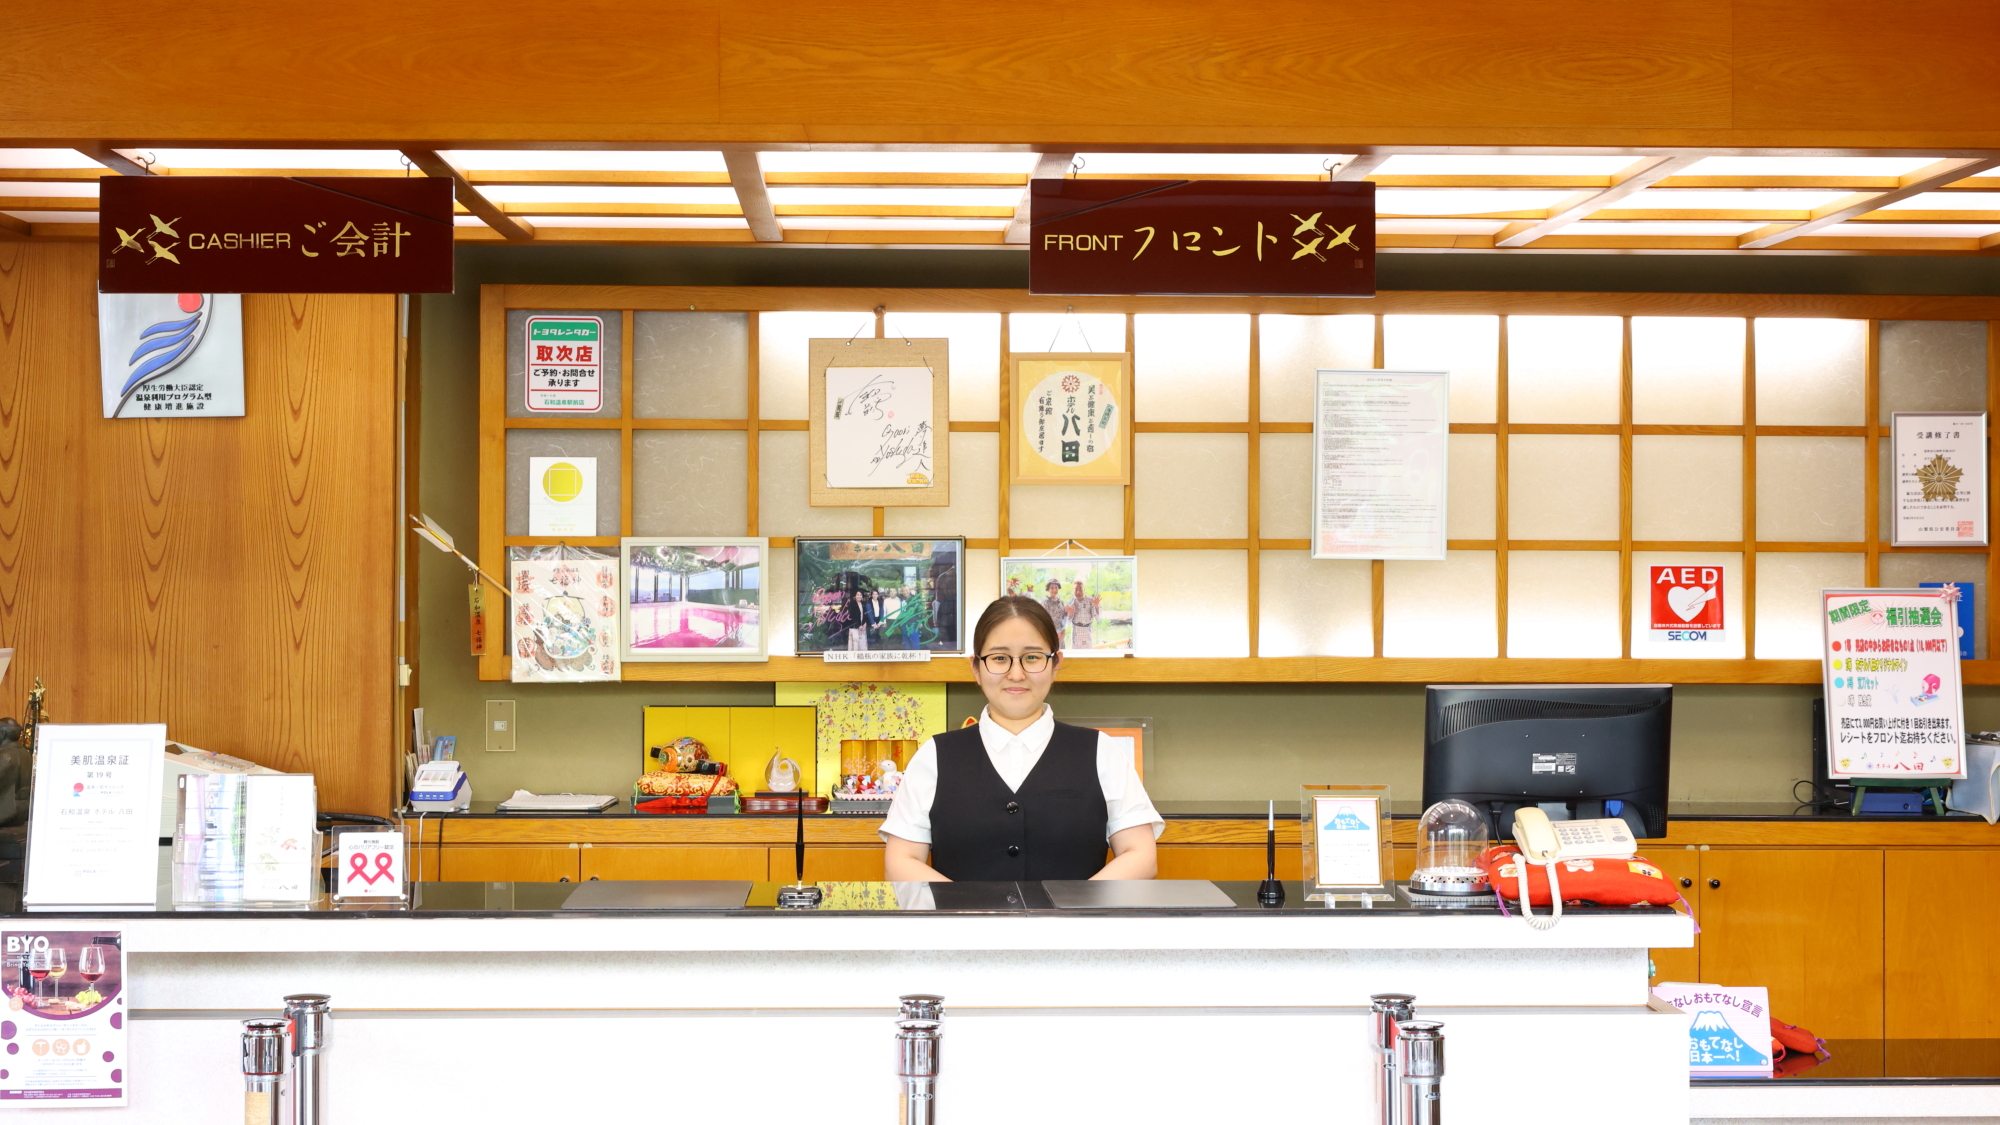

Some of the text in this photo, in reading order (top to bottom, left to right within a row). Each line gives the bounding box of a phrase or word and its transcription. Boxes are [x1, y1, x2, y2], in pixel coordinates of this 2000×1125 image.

[189, 221, 411, 258] CASHIER ご会計
[1044, 221, 1278, 262] FRONT フロント
[533, 328, 597, 336] トヨタレンタカー
[536, 345, 593, 362] 取次店
[533, 368, 596, 377] ご予約・お問合せ
[142, 383, 204, 392] 厚生労働大臣認定
[548, 378, 580, 387] 承ります
[135, 392, 212, 402] 温泉利用プログラム型
[143, 402, 205, 411] 健康増進施設
[1916, 431, 1960, 439] 受講修了書
[1655, 567, 1719, 584] AED
[1828, 599, 1872, 625] 期間限定
[1885, 606, 1944, 628] 福引抽選会
[1667, 630, 1707, 641] SECOM
[1840, 731, 1957, 744] レシートをフロント迄お持ちください。
[70, 754, 130, 766] 美肌温泉証
[1875, 762, 1924, 771] ホテル八田
[86, 771, 112, 779] 第19号
[6, 935, 50, 953] BYO
[1690, 1036, 1744, 1053] おもてなし
